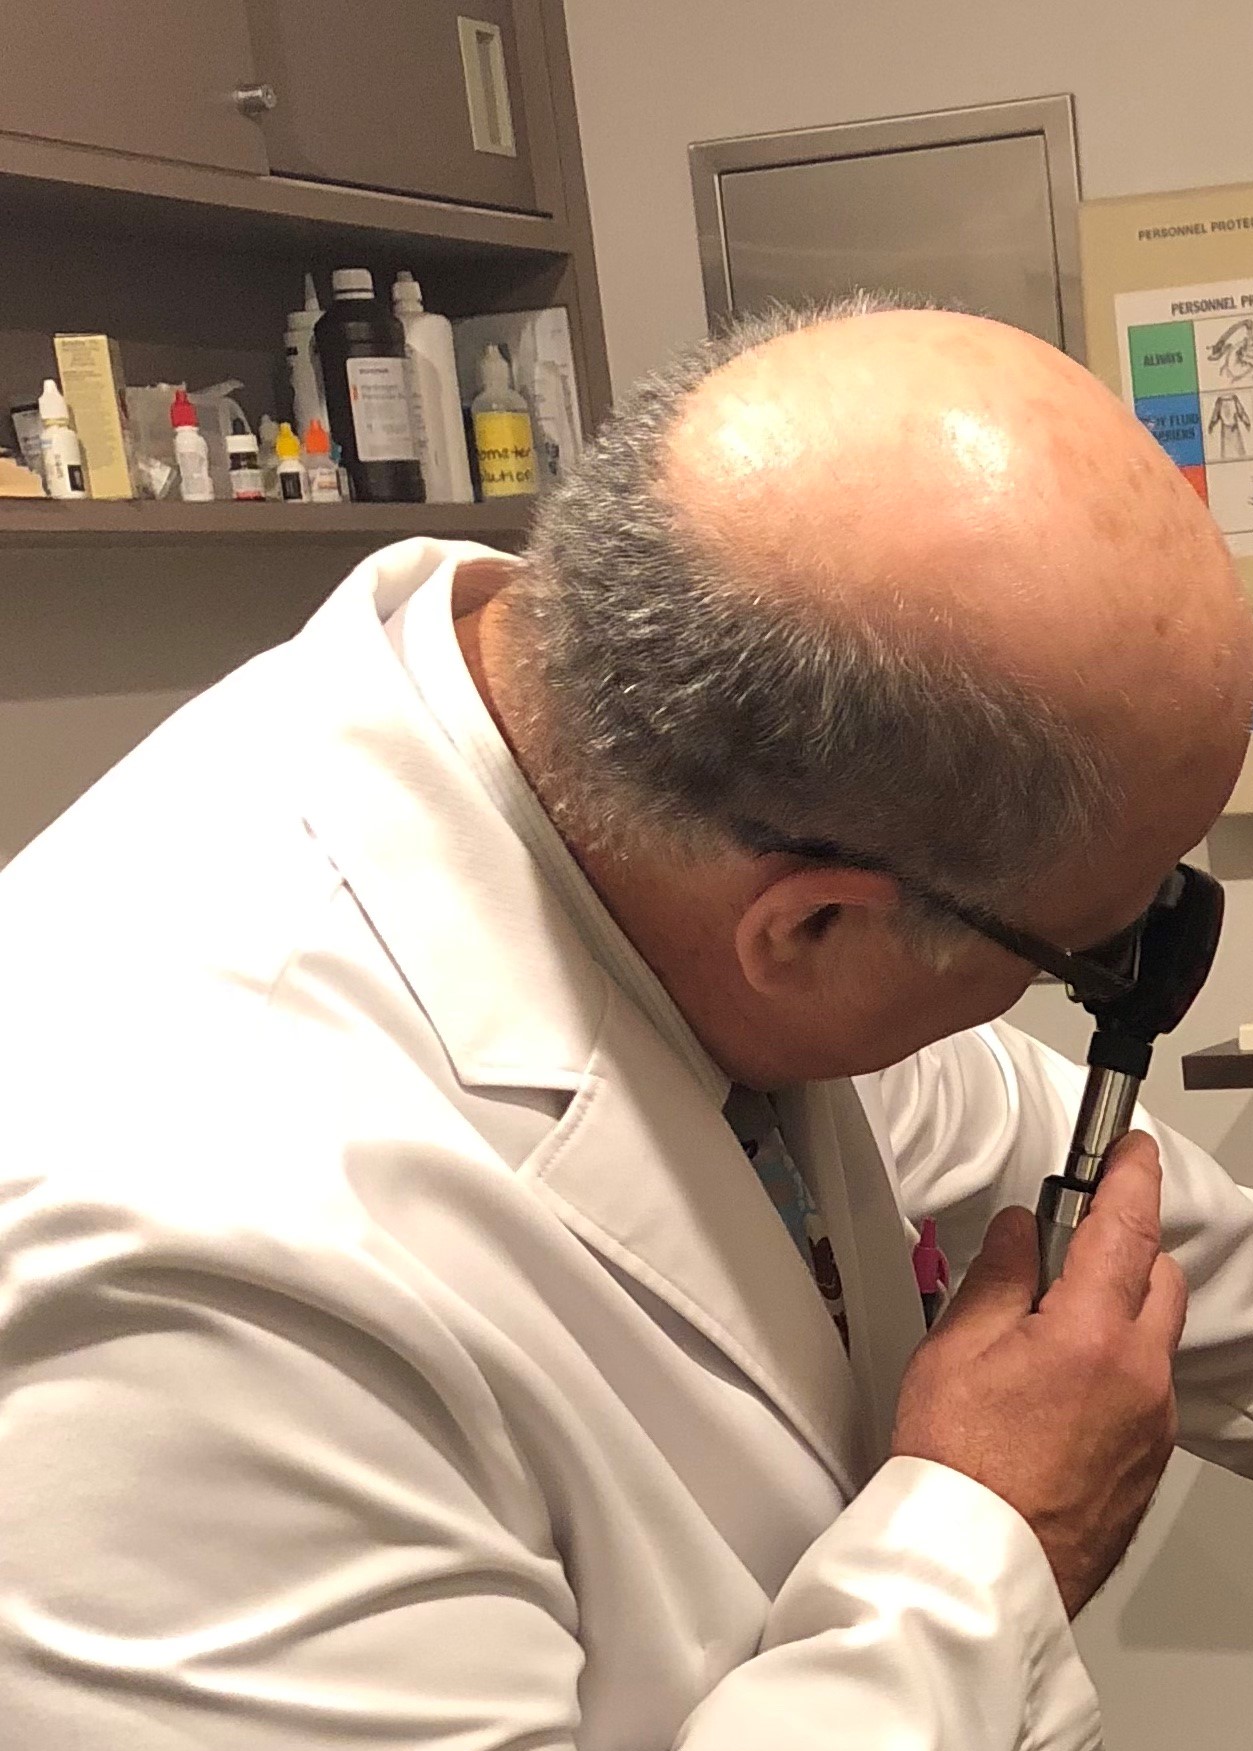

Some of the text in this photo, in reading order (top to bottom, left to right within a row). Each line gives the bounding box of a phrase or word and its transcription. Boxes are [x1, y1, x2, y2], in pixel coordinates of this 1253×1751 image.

[1138, 223, 1207, 240] PERSONNEL
[1171, 296, 1237, 316] PERSONNEL
[1143, 352, 1183, 367] ALWAYS
[1169, 413, 1199, 427] FLUID
